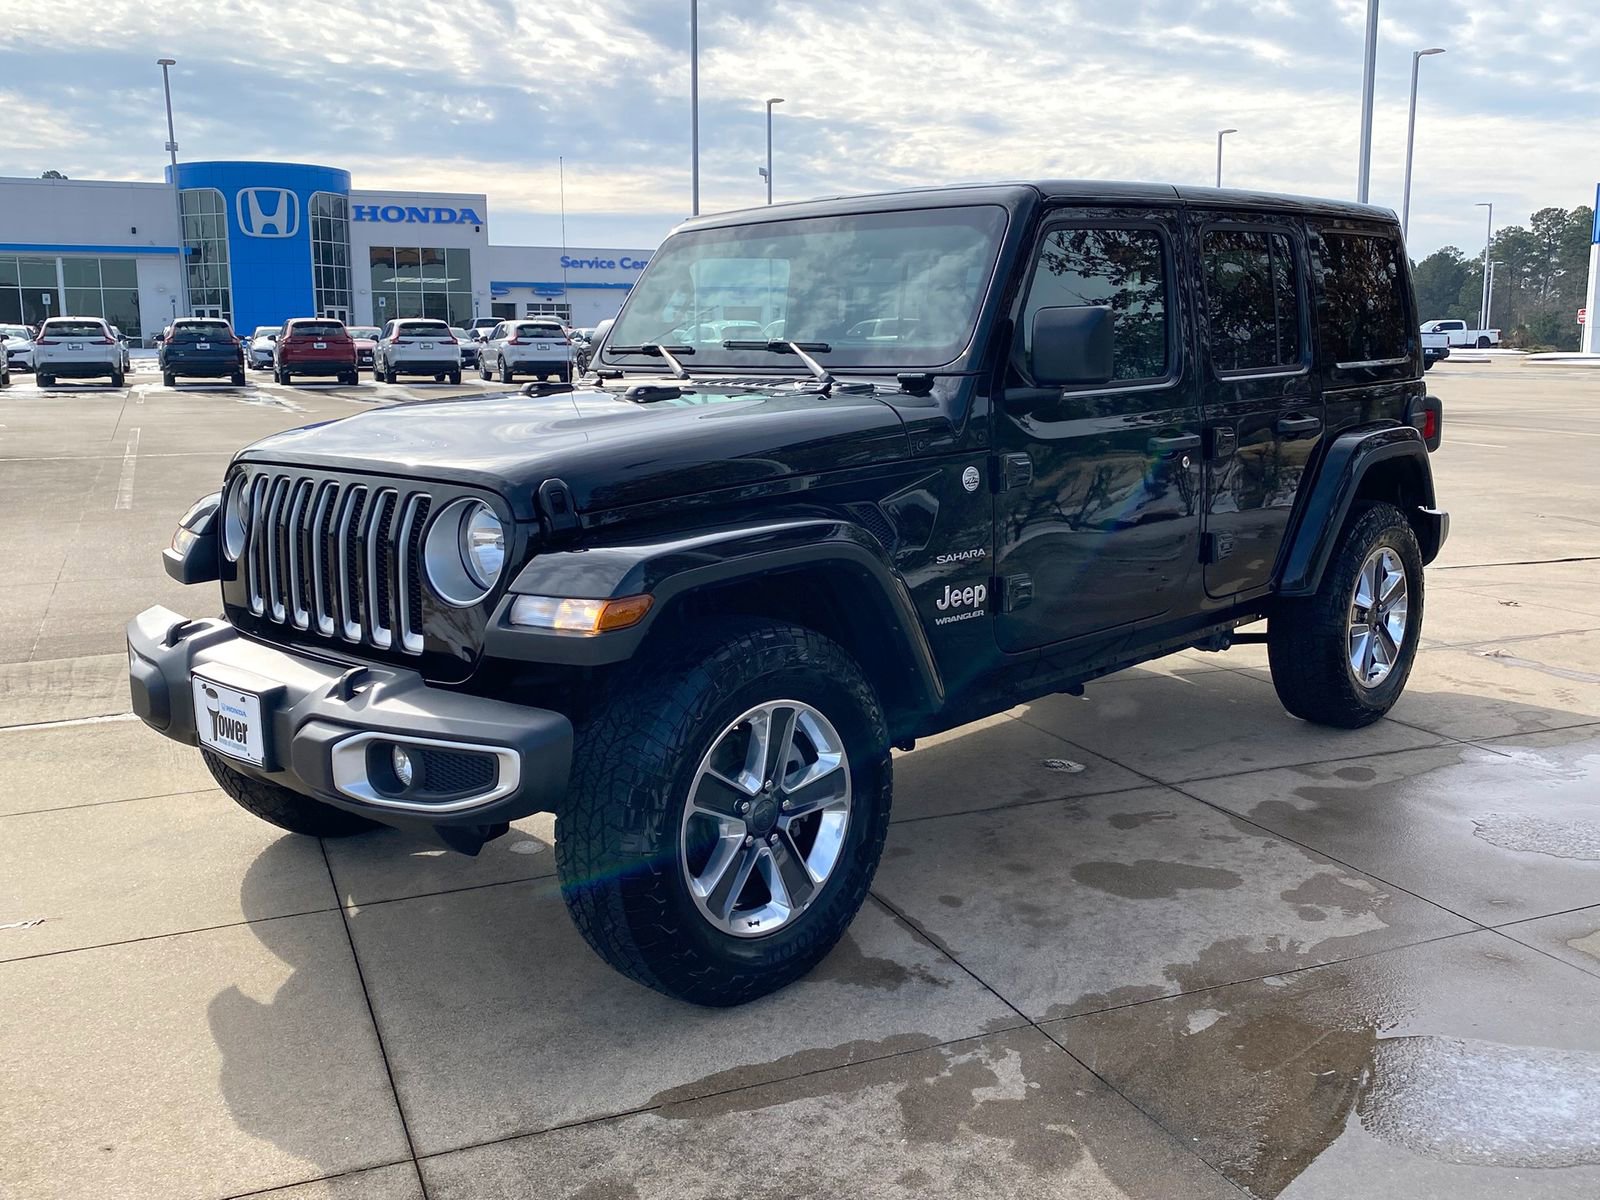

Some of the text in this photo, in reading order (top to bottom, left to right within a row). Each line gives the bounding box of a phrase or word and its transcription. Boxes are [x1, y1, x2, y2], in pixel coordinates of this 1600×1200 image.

[352, 205, 483, 225] HONDA
[560, 255, 616, 270] Service
[936, 548, 986, 564] SAHARA
[936, 584, 987, 611] Jeep
[935, 609, 985, 626] WRANGLER
[206, 704, 248, 745] Tower
